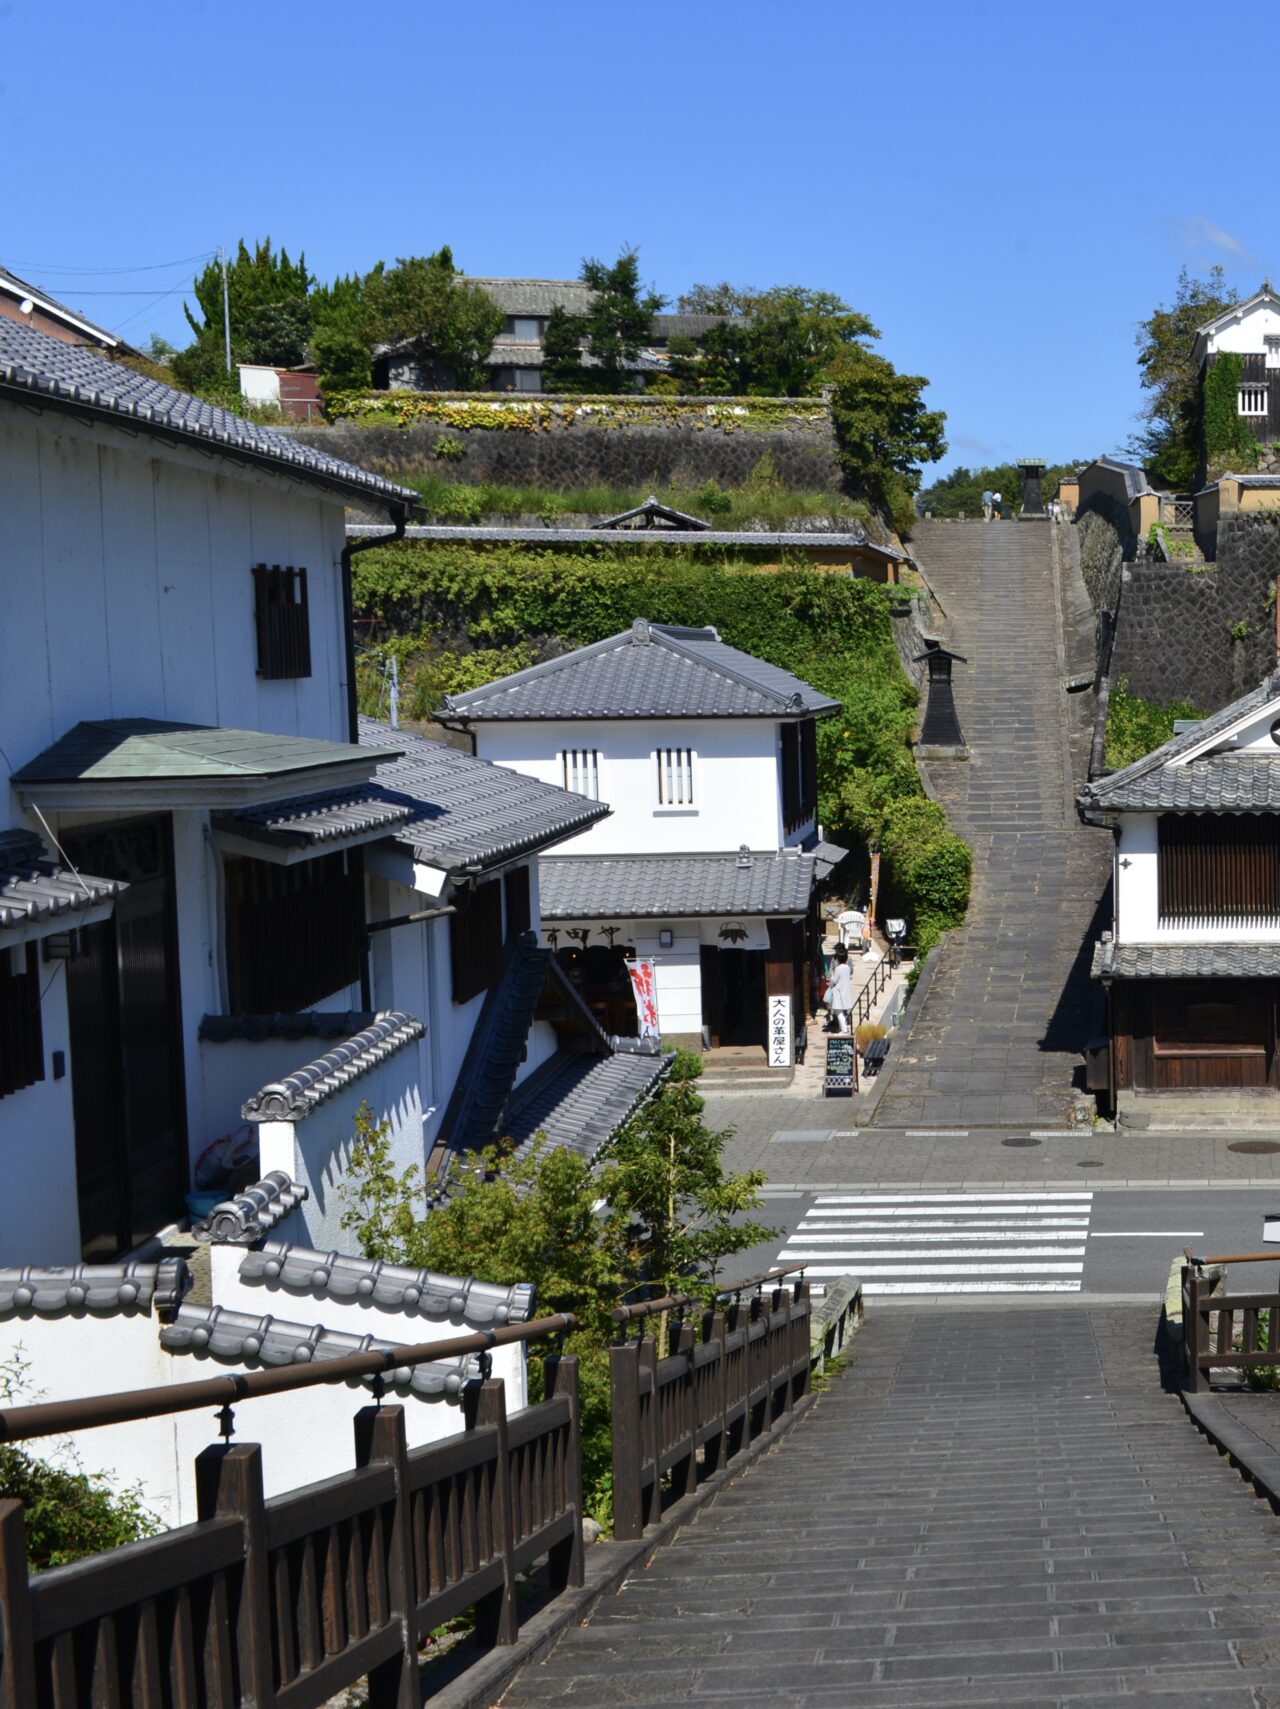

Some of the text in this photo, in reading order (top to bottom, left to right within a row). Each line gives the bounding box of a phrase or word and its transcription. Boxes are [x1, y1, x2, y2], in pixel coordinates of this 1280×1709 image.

[773, 998, 786, 1064] 大人の革屋さん
